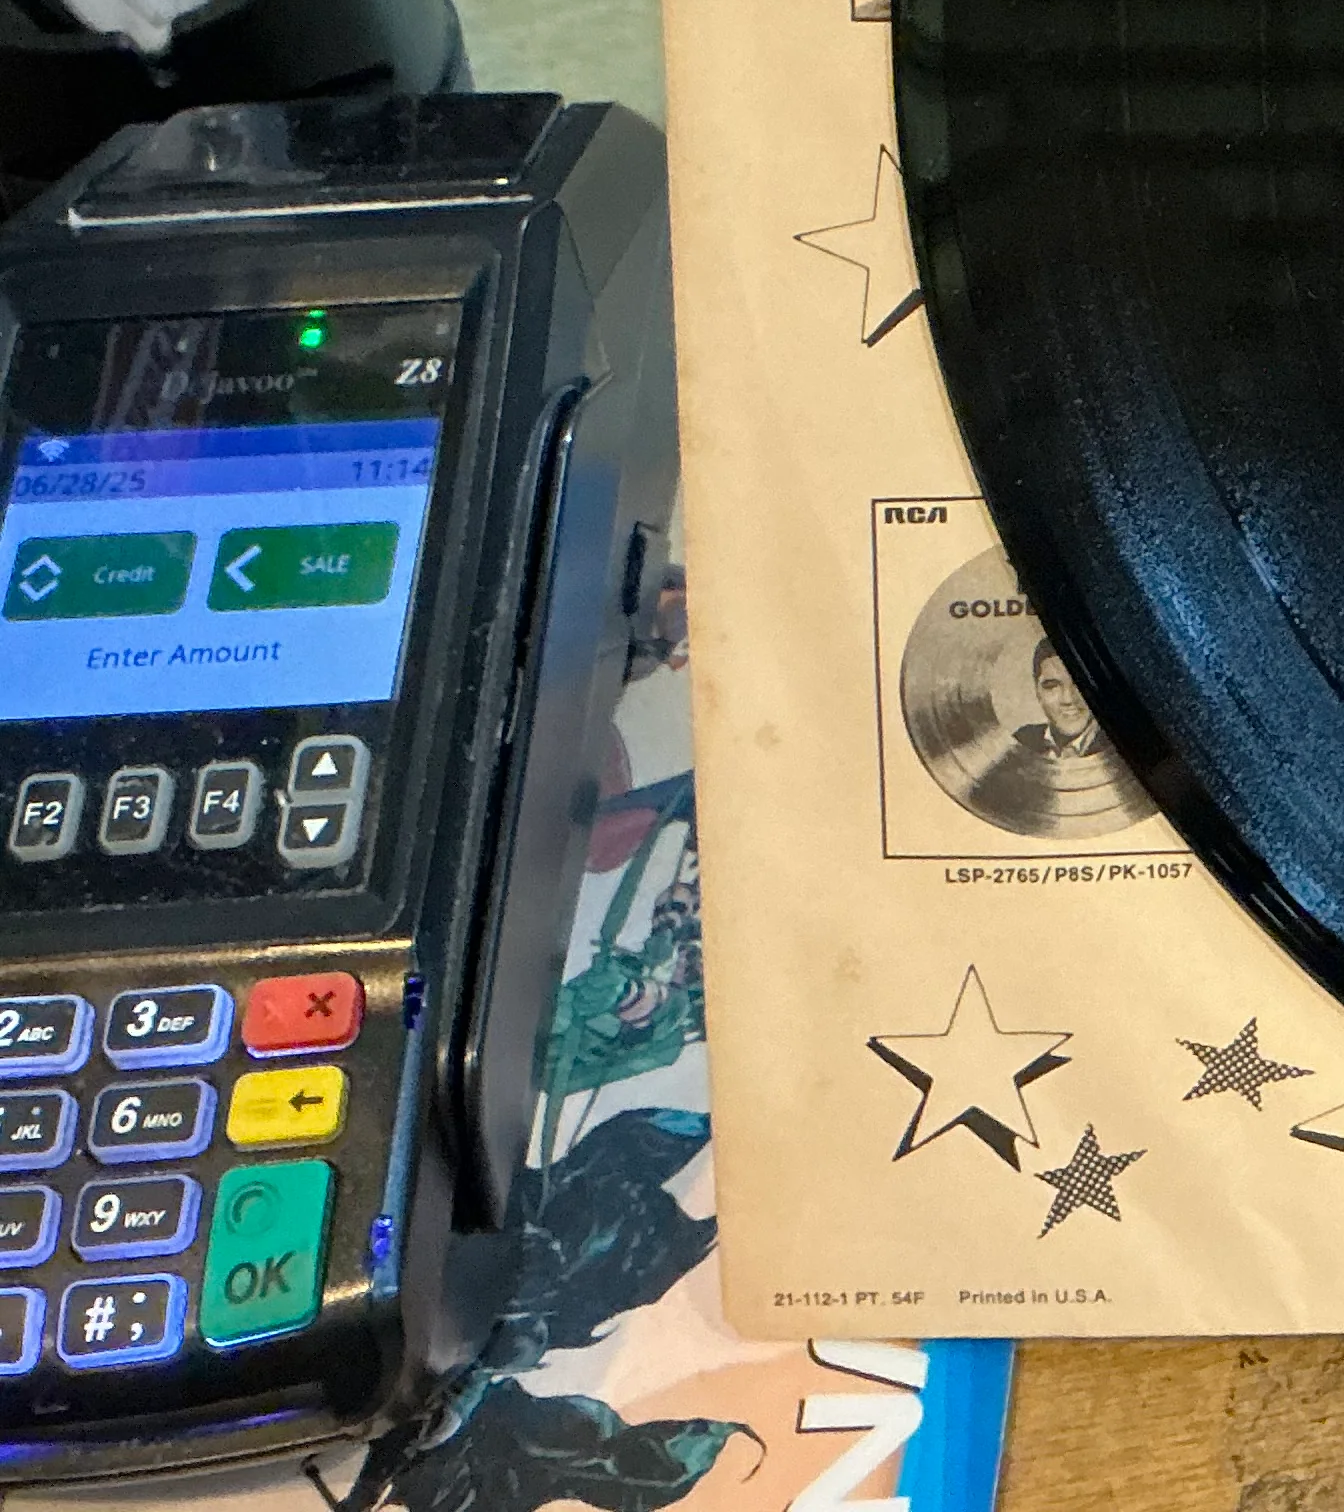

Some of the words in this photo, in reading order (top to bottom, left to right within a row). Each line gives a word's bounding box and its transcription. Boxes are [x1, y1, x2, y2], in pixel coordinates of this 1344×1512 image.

[395, 358, 442, 385] Z8
[15, 469, 146, 497] 06/28/25
[352, 458, 431, 483] 11:14
[884, 506, 948, 524] RCA
[93, 565, 156, 585] Credit
[301, 554, 351, 575] SALE
[87, 648, 157, 670] Enter
[167, 640, 282, 665] Amount
[23, 801, 64, 826] F2
[112, 795, 151, 820] F3
[203, 789, 240, 815] F4
[945, 863, 1193, 884] LSP-2765/P8S/PK-1057
[127, 999, 158, 1037] 3
[157, 1015, 195, 1033] DEF
[17, 1026, 55, 1042] ABC
[111, 1095, 142, 1134] 6
[143, 1112, 183, 1129] MNO
[10, 1123, 43, 1141] JKL
[90, 1193, 121, 1233] 9
[124, 1209, 166, 1228] WXY
[223, 1250, 295, 1304] OK
[774, 1291, 848, 1307] 21-112-1
[958, 1288, 1026, 1305] Printed
